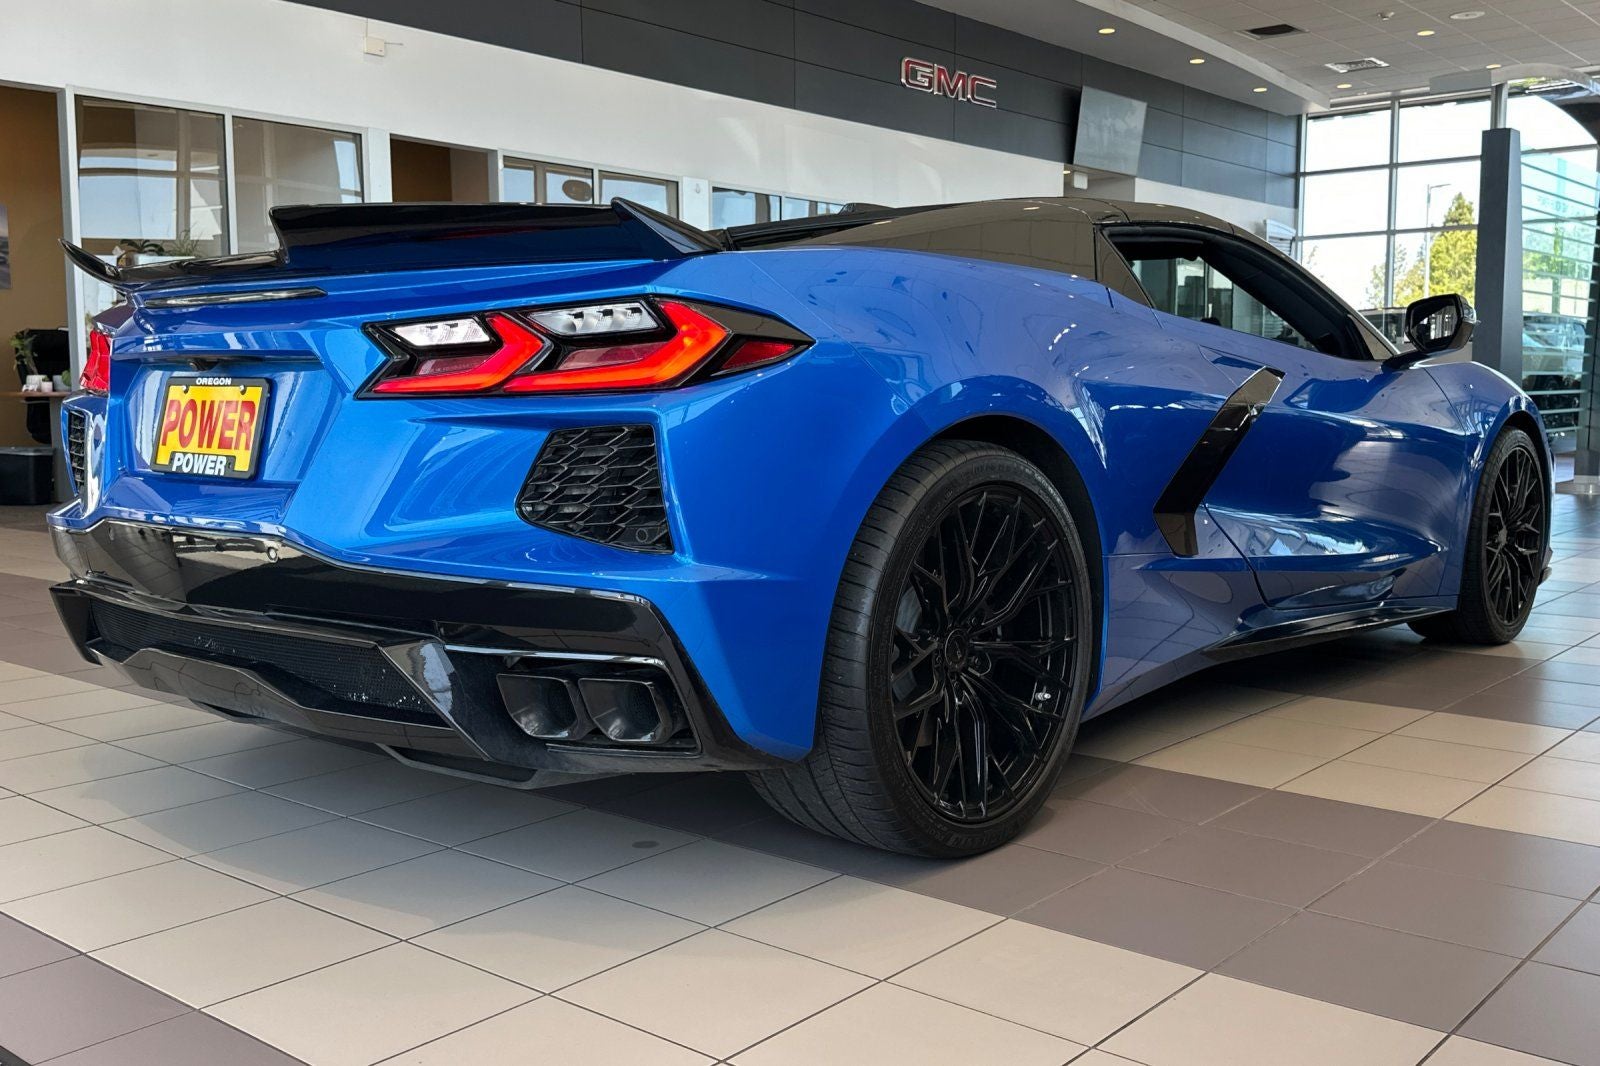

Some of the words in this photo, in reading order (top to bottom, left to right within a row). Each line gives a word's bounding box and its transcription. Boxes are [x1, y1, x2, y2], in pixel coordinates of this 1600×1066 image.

[901, 57, 997, 108] GMC
[195, 377, 232, 386] OREGON
[161, 398, 257, 451] POWER
[171, 452, 227, 477] POWER
